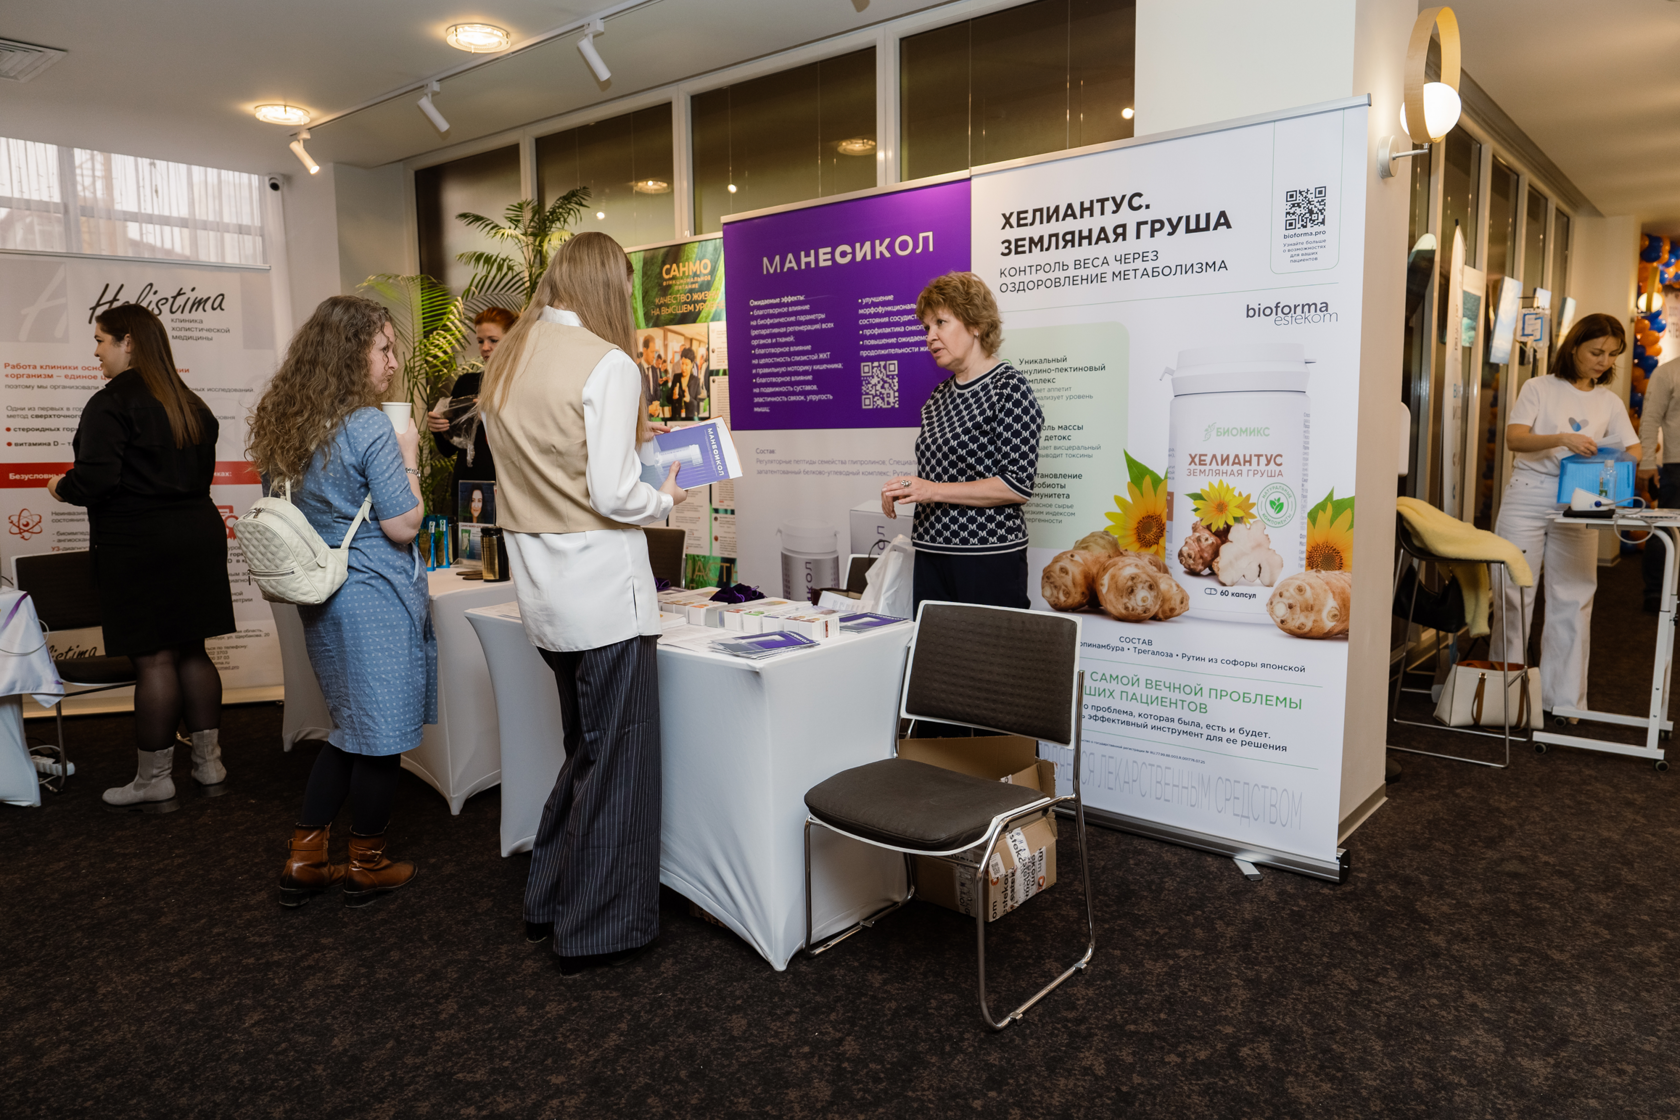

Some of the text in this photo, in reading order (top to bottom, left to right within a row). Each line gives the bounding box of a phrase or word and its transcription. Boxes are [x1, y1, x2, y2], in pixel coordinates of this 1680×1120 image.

[1000, 191, 1151, 230] ХЕЛИАНТУС.
[1000, 210, 1232, 257] ЗЕМЛЯНАЯ ГРУША
[1283, 230, 1326, 239] bioforma.pro
[762, 231, 934, 275] МАНЕСИКОЛ
[662, 258, 711, 279] САНМО
[999, 250, 1159, 279] КОНТРОЛЬ ВЕСА ЧЕРЕЗ
[999, 259, 1229, 294] ОЗДОРОВЛЕНИЕ МЕТАБОЛИЗМА
[655, 290, 719, 305] КАЧЕСТВО ЖИЗНИ
[749, 295, 805, 306] Ожидаемые эффекты:
[862, 295, 894, 305] улучшение
[651, 300, 725, 316] НА ВЫСШЕМ УРОВНЕ
[753, 304, 810, 316] благотворное влияние
[858, 303, 916, 314] морфофункциональ
[1246, 301, 1329, 318] bioforma
[757, 316, 796, 325] биофизические
[797, 313, 825, 321] параметры
[859, 314, 917, 325] состояния сосудист
[1273, 311, 1338, 326] estekom
[171, 326, 231, 334] холистической
[750, 327, 786, 336] (репаративная
[787, 323, 821, 333] регенерация)
[863, 326, 904, 336] профилактика
[751, 338, 771, 346] органов
[755, 346, 789, 354] благотворное
[860, 347, 918, 357] продолжительности
[791, 353, 818, 362] слизистой
[1019, 355, 1067, 365] Уникальный
[757, 366, 786, 375] правильную
[813, 363, 843, 371] кишечника;
[756, 375, 791, 384] благотворное
[760, 385, 793, 393] подвижность
[807, 394, 833, 402] упругость
[1216, 426, 1270, 437] БИОМИКС
[1044, 434, 1072, 442] детокс
[756, 458, 792, 466] Регуляторные
[889, 458, 918, 466] Специаль
[1188, 453, 1283, 467] ХЕЛИАНТУС
[1186, 468, 1284, 478] ЗЕМЛЯНАЯ ГРУША
[1220, 589, 1256, 599] 60 капсул
[1119, 636, 1153, 646] СОСТАВ
[1080, 642, 1125, 652] опинамбура
[1133, 646, 1173, 658] Трегалоза
[1181, 652, 1206, 662] Рутин
[1220, 658, 1258, 668] софоры
[1260, 662, 1305, 673] японской
[1090, 671, 1302, 710] САМОЙ ВЕЧНОЙ ПРОБЛЕМЫ
[1084, 685, 1208, 714] ШИХ ПАЦИЕНТОВ
[1091, 704, 1136, 718] проблема,
[1138, 711, 1175, 723] которая
[1177, 717, 1203, 729] была,
[1205, 723, 1226, 732] есть
[1238, 727, 1271, 739] будет.
[1087, 714, 1148, 729] эффективный
[1150, 724, 1204, 739] инструмент
[1206, 734, 1223, 743] для
[1240, 739, 1287, 752] решения
[1098, 756, 1303, 830] ЛЕКАРСТВЕННЫМ СРЕДСТВОМ
